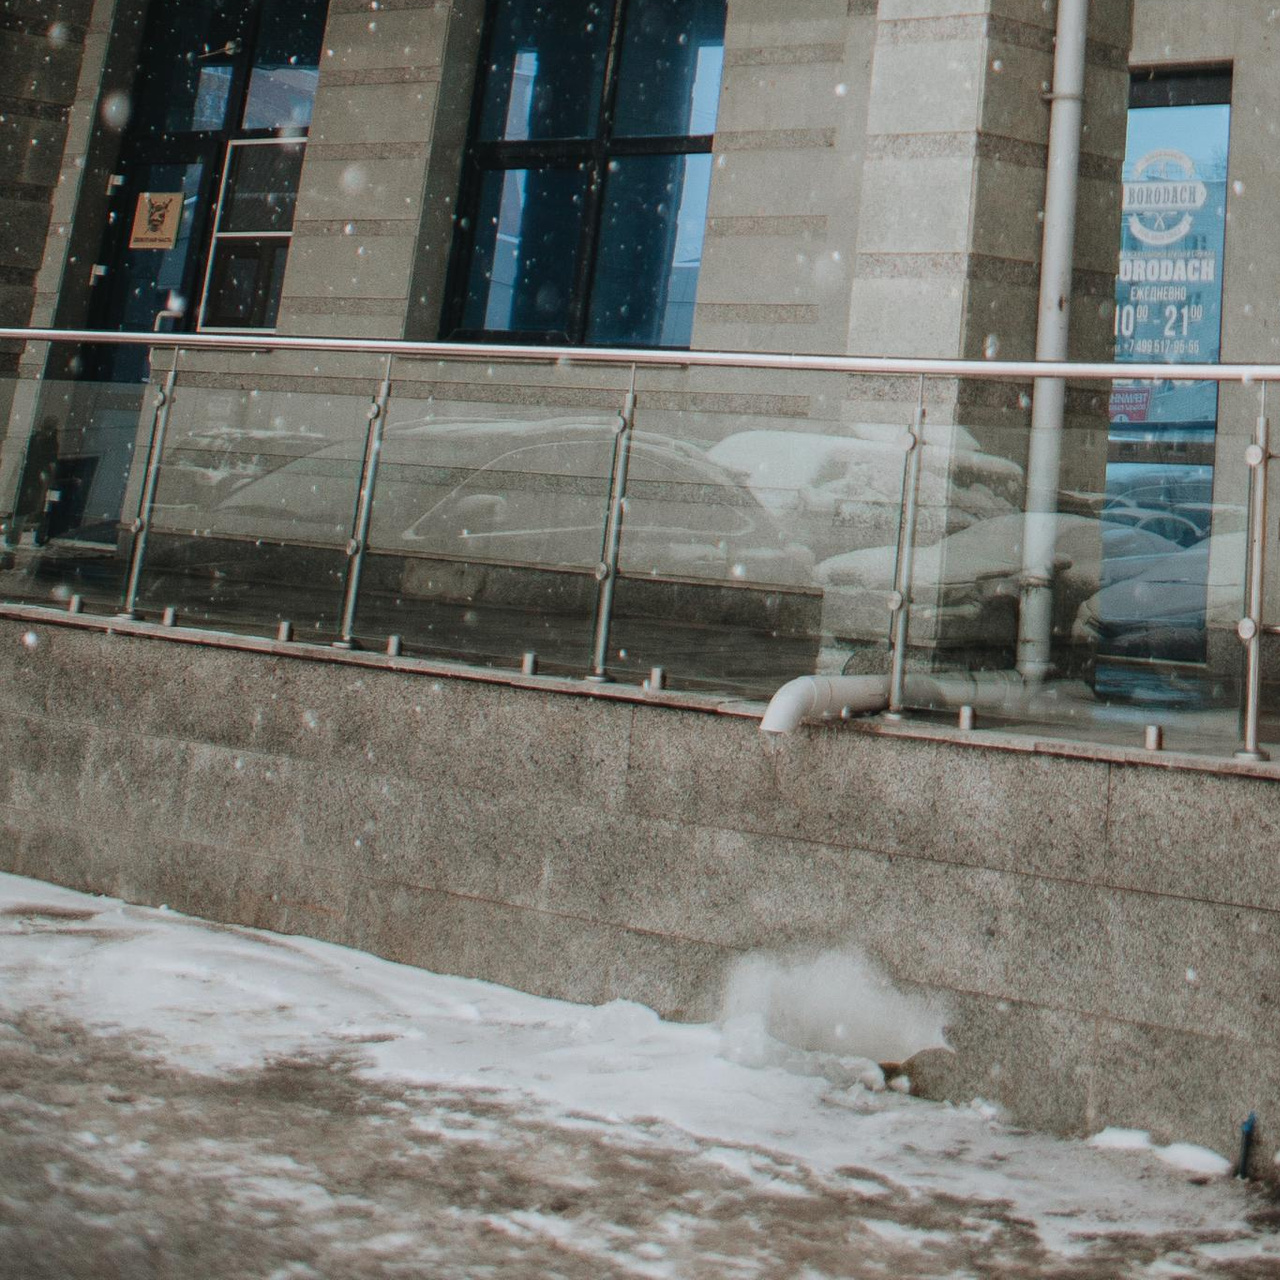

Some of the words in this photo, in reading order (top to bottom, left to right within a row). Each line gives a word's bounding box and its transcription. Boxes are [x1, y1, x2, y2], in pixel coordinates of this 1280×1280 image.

[1128, 185, 1197, 206] BORODACH
[1119, 258, 1215, 282] ORODACH
[1130, 285, 1187, 302] ЕЖЕДНЕВНО
